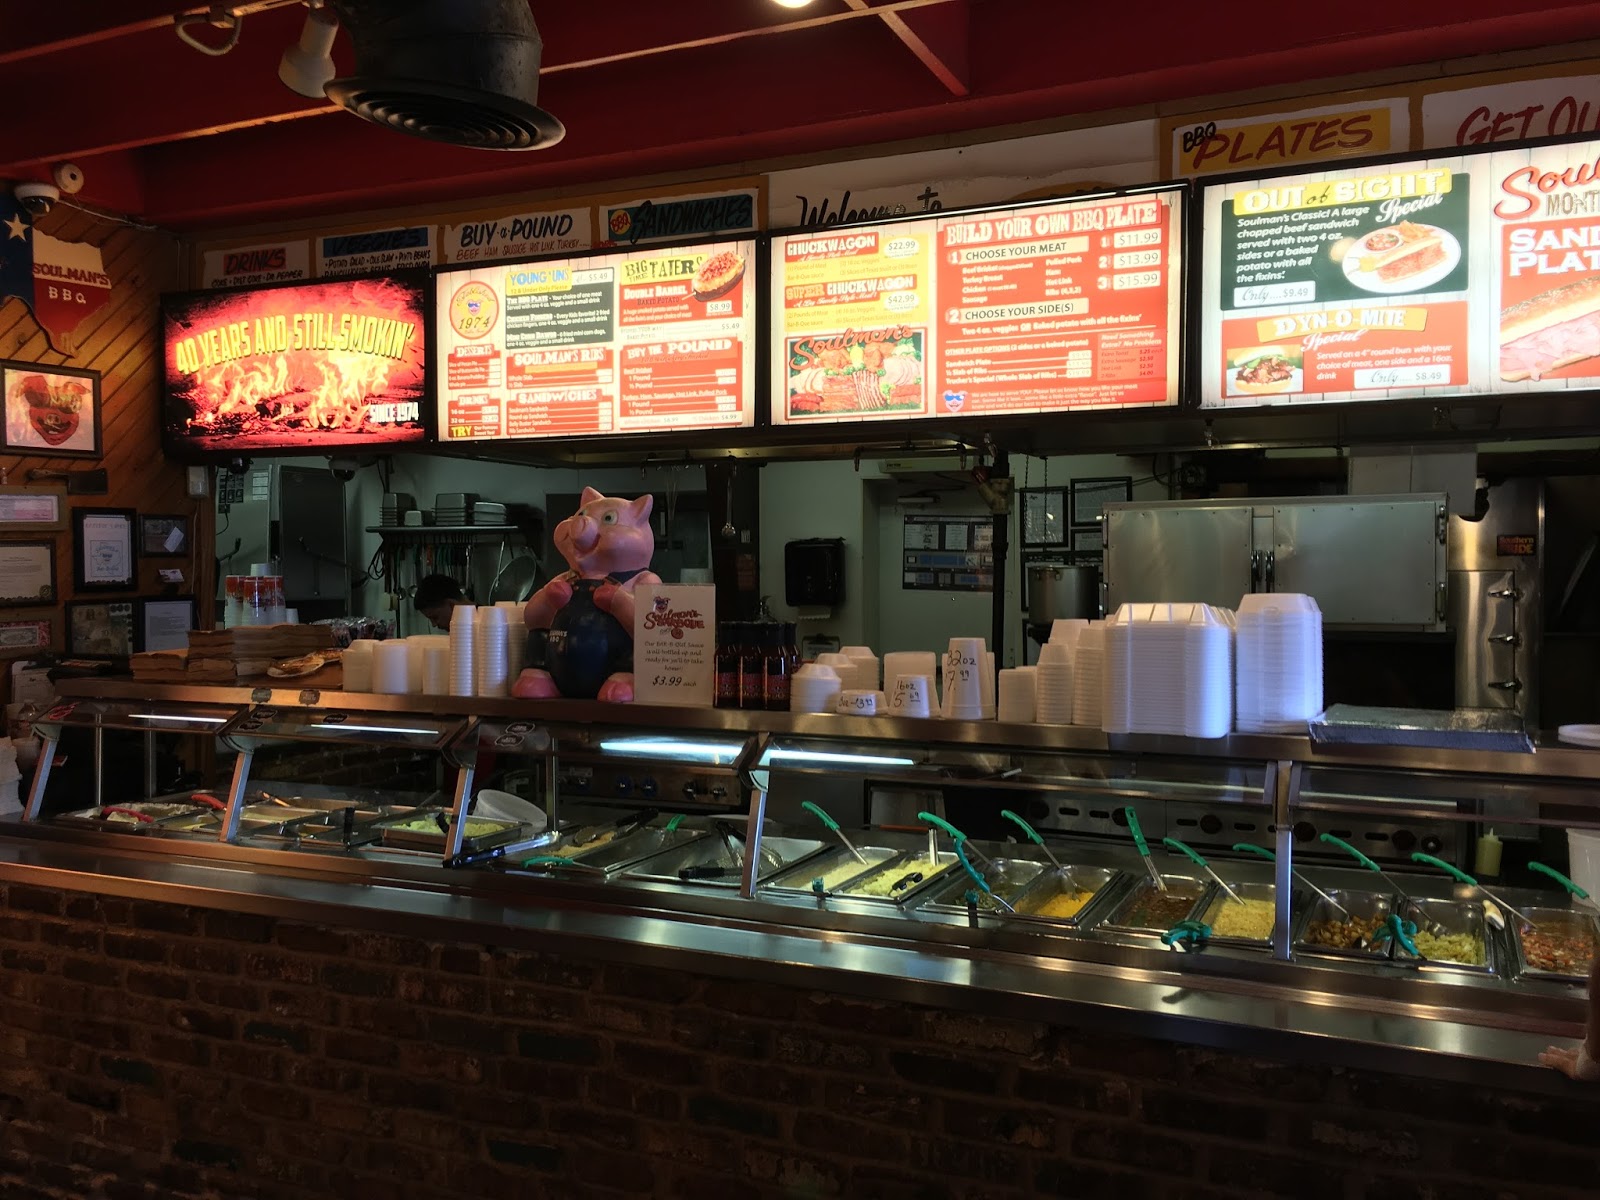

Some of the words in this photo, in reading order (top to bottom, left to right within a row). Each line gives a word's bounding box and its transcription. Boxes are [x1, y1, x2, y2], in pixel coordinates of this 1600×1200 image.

[1456, 104, 1544, 147] GET
[1182, 121, 1216, 153] BBQ
[1192, 114, 1373, 170] PLATES
[1243, 186, 1306, 212] OUT
[1306, 184, 1331, 205] of
[1335, 172, 1444, 204] SIGHT
[1237, 215, 1290, 228] Soulman's
[1331, 209, 1340, 217] A
[1341, 206, 1370, 218] large
[1375, 193, 1444, 224] Special
[630, 195, 752, 245] SANDWICHES
[946, 221, 993, 246] BUILD
[995, 216, 1033, 240] YOUR
[1035, 213, 1071, 236] OWN
[1072, 209, 1105, 231] BBQ
[1106, 202, 1157, 229] PLATE
[1237, 226, 1282, 239] chopped
[1283, 223, 1307, 234] beef
[1307, 218, 1360, 232] sandwich
[460, 222, 497, 248] BUY
[510, 214, 573, 241] POUND
[1119, 232, 1159, 246] $11.99
[787, 235, 876, 256] CHUCKWAGON
[888, 241, 916, 251] $22.99
[1237, 238, 1271, 250] served
[1272, 236, 1296, 247] with
[1296, 234, 1317, 244] two
[1319, 233, 1327, 242] 4
[1327, 232, 1344, 241] oz.
[456, 249, 480, 261] BEEF
[965, 248, 1007, 262] CHOOSE
[1009, 245, 1037, 256] YOUR
[1038, 241, 1067, 253] MEAT
[1118, 252, 1159, 266] $13.99
[1236, 250, 1263, 261] sides
[1263, 249, 1275, 259] or
[1276, 248, 1284, 257] a
[1285, 244, 1319, 256] baked
[224, 249, 286, 275] DRINKS
[624, 260, 648, 277] BIG
[1236, 260, 1272, 273] potato
[1273, 258, 1296, 269] with
[1297, 256, 1312, 266] all
[32, 262, 110, 286] SOULMAN'S
[276, 269, 304, 280] PEPPER
[510, 271, 547, 286] YOUNG
[588, 272, 608, 282] $5.49
[1118, 273, 1158, 287] $15.99
[1236, 273, 1254, 283] the
[624, 287, 655, 301] DOUBLE
[786, 284, 825, 301] SUPER
[827, 276, 914, 296] CHUCKWAGON
[1283, 287, 1309, 299] $9.49
[709, 303, 731, 312] $8.99
[887, 295, 915, 304] $42.99
[965, 308, 1006, 321] CHOOSE
[1008, 305, 1036, 316] YOUR
[1038, 302, 1074, 315] SIDE(S)
[459, 316, 491, 330] 1974
[721, 323, 740, 331] $5.49
[1273, 309, 1406, 336] DYN-O-MITE
[176, 337, 201, 375] 40
[199, 320, 252, 367] YEARS
[255, 315, 288, 355] AND
[294, 312, 337, 351] STILL
[340, 313, 416, 361] SMOKIN'
[627, 347, 646, 359] BUY
[667, 339, 733, 355] POUND
[789, 324, 914, 370] Soulman's
[1301, 328, 1369, 353] Special
[515, 350, 579, 366] SOULMAN'S
[581, 347, 604, 361] RIBS
[1316, 350, 1343, 361] Served
[1343, 350, 1354, 359] on
[1371, 346, 1394, 357] round
[1394, 345, 1412, 355] bun
[1413, 345, 1432, 355] with
[1432, 344, 1453, 356] your
[1316, 360, 1341, 370] choice
[1342, 359, 1351, 369] of
[1374, 358, 1390, 367] one
[1390, 356, 1407, 366] side
[1407, 356, 1424, 365] and
[1316, 371, 1337, 381] drink
[1414, 371, 1442, 382] $8.49
[518, 390, 597, 404] SANDWICHES
[369, 403, 396, 423] SINCE
[396, 401, 419, 422] 1974
[451, 426, 472, 438] TRY
[1499, 543, 1534, 555] IDE
[652, 675, 683, 687] $3.99
